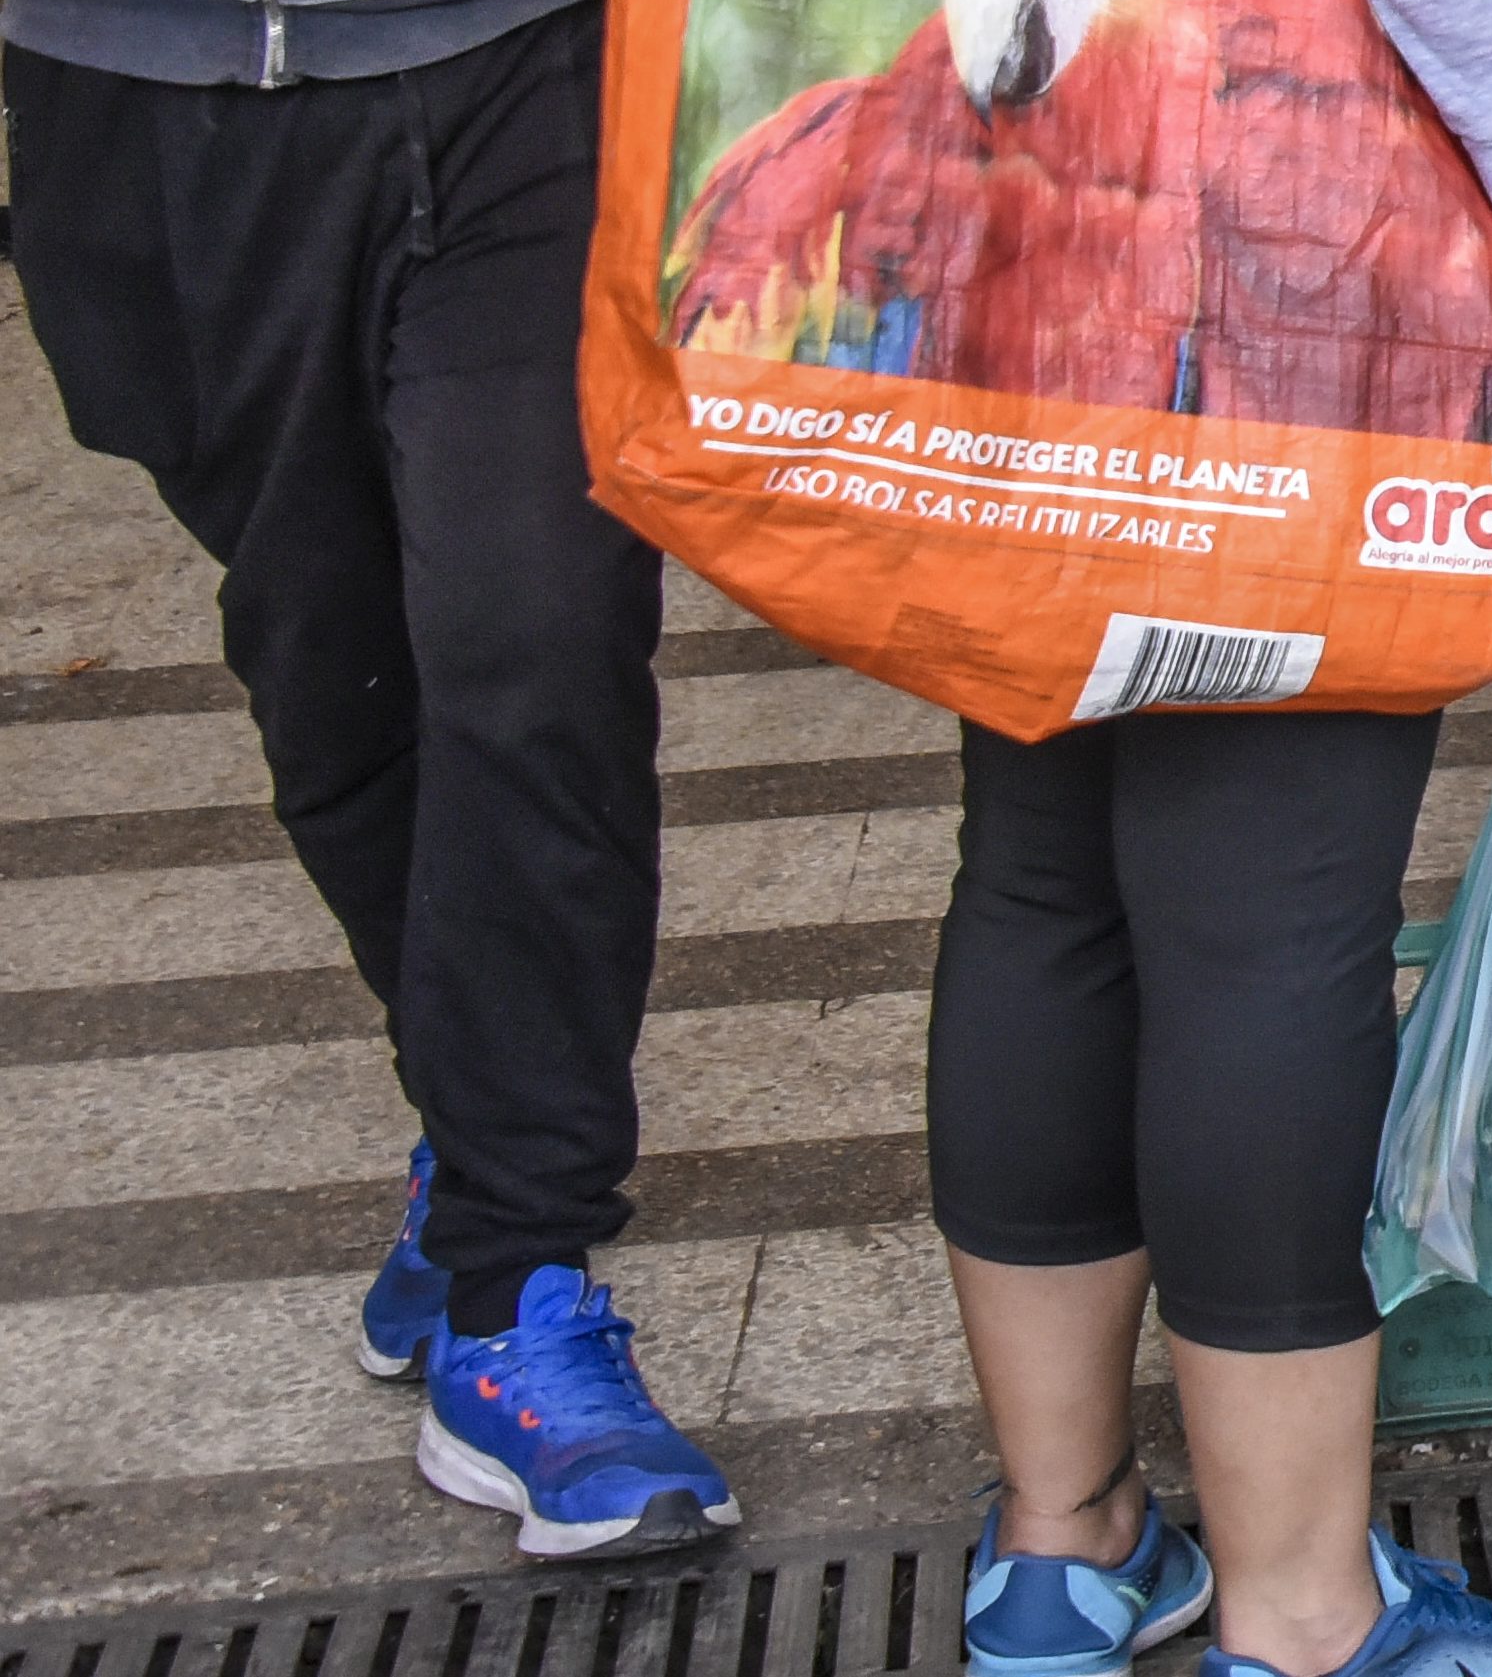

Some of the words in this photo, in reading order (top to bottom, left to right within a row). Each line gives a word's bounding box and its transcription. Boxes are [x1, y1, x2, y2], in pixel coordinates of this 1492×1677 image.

[689, 394, 744, 431] YO
[746, 401, 845, 439] DIGO
[845, 410, 894, 444] SÍ
[883, 420, 917, 453] A
[922, 425, 1099, 477] PROTEGER
[1104, 447, 1142, 483] EL
[1148, 452, 1310, 501] PLANETA
[764, 465, 839, 499] USO
[1418, 552, 1430, 565] al
[1433, 554, 1472, 571] mejor
